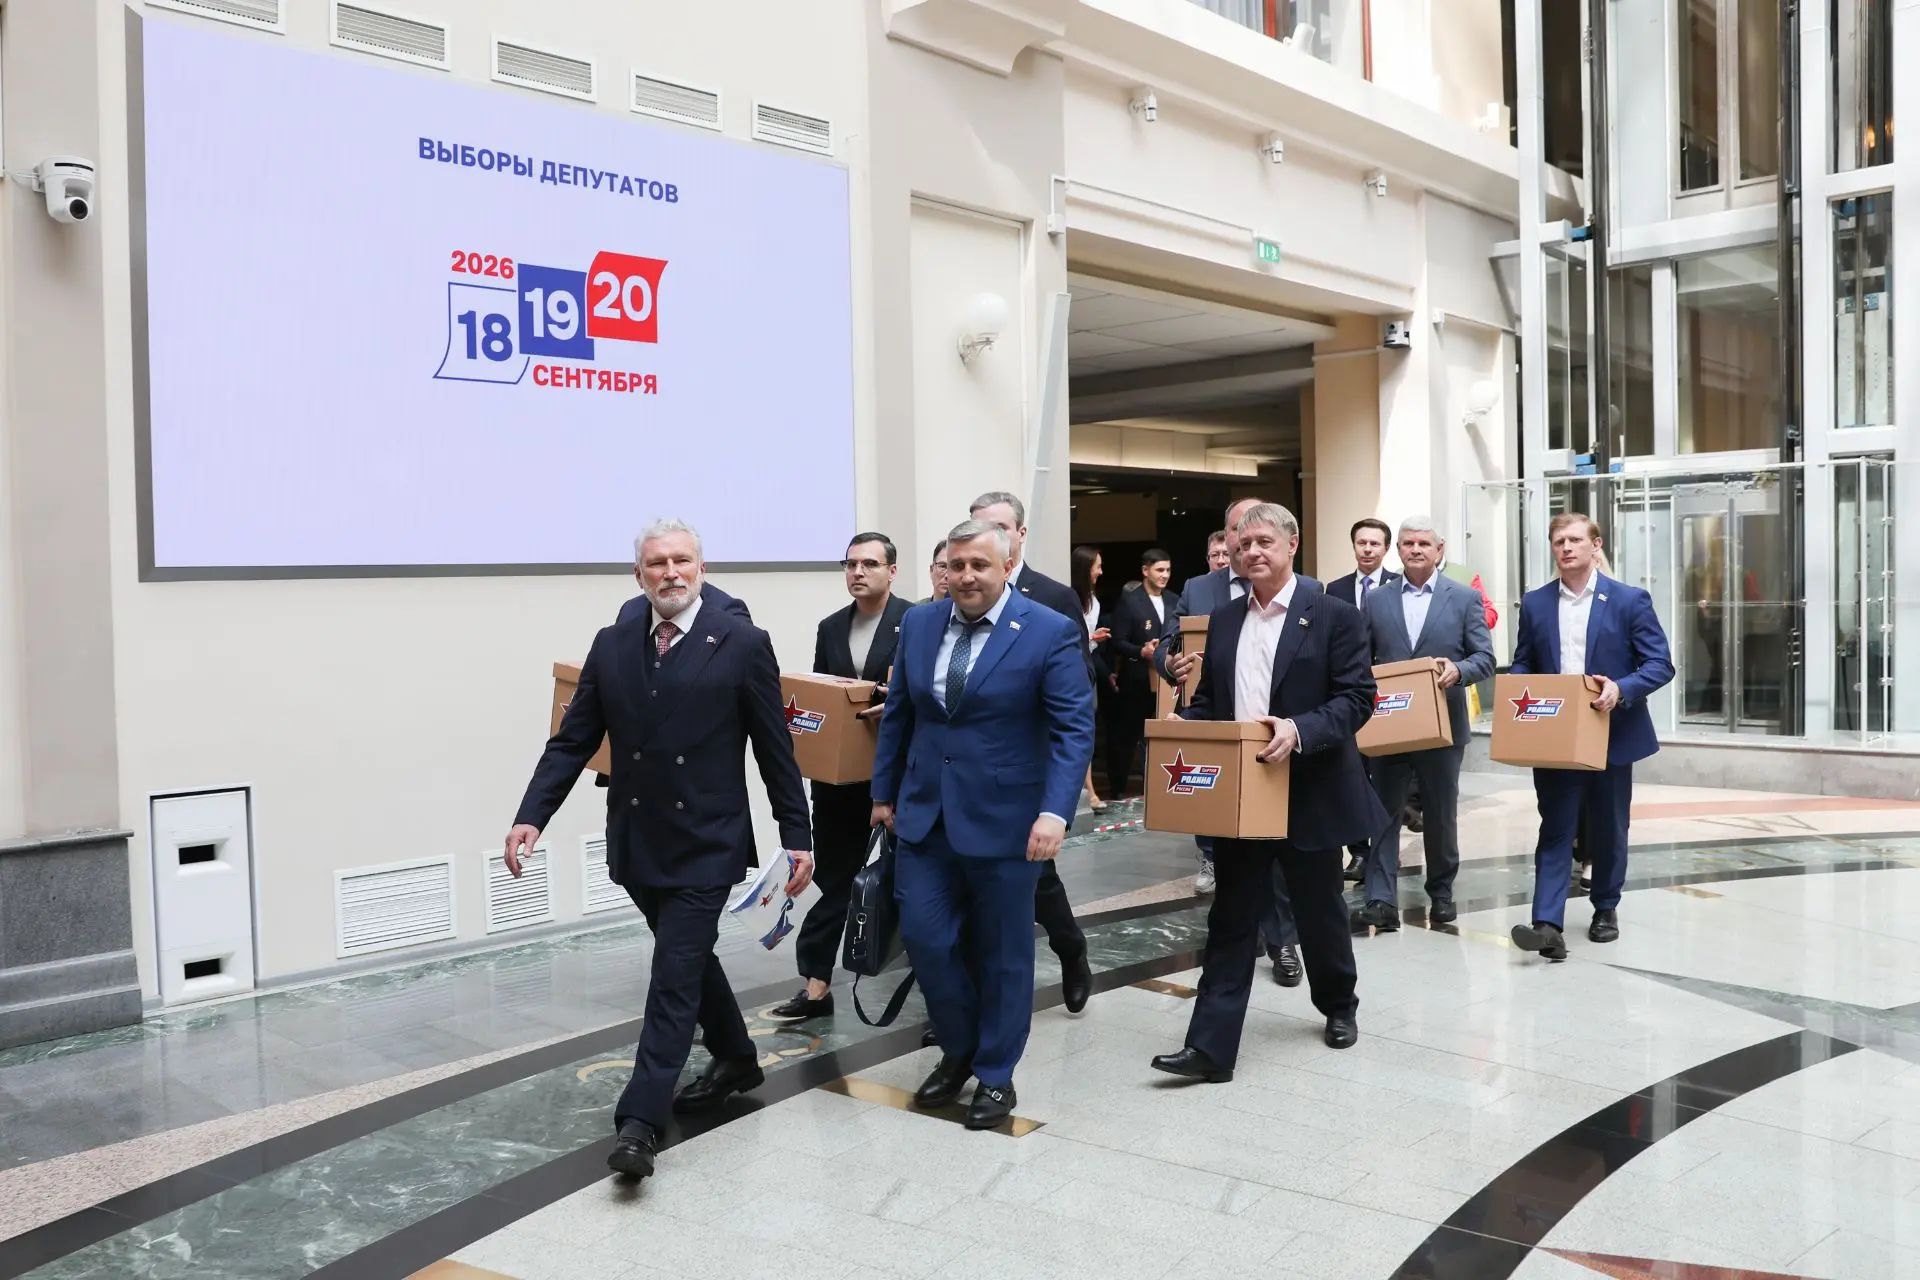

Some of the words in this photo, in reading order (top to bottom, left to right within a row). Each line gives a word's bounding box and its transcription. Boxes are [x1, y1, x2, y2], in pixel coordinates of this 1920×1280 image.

[419, 137, 533, 178] ВЫБОРЫ
[540, 161, 679, 204] ДЕПУТАТОВ
[451, 250, 514, 280] 2026
[524, 287, 579, 341] 19
[592, 271, 653, 322] 20
[457, 310, 513, 362] 18
[532, 364, 658, 395] СЕНТЯБРЯ
[792, 717, 817, 729] РОДИНА
[1181, 775, 1212, 785] РОДИНА
